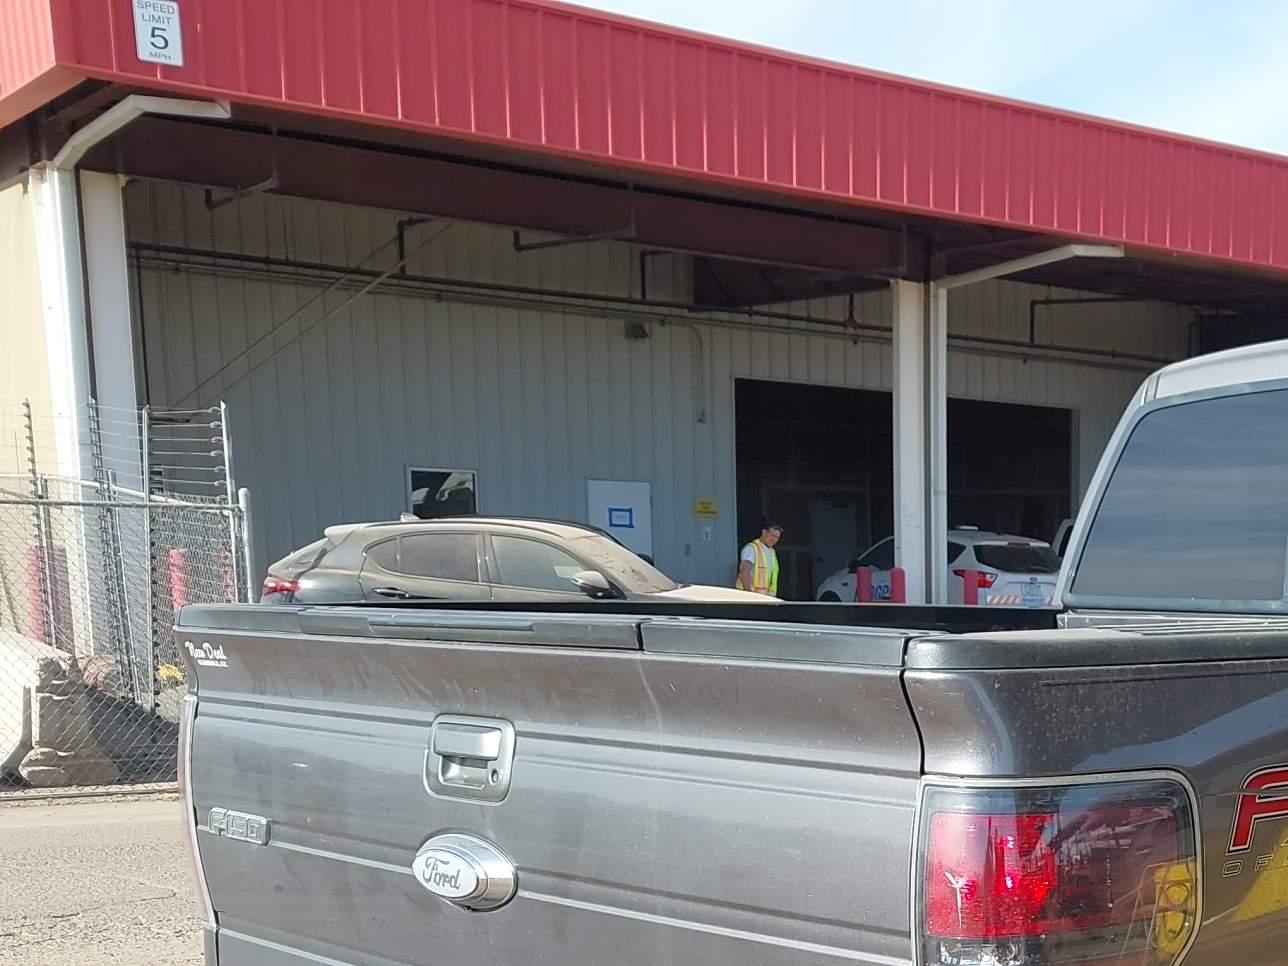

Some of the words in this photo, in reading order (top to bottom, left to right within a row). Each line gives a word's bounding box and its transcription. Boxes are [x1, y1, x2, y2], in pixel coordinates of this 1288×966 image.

[137, 0, 175, 14] SPEED
[142, 12, 171, 25] LIMIT
[150, 26, 169, 50] 5
[150, 52, 171, 61] MPH
[423, 856, 461, 891] Ford
